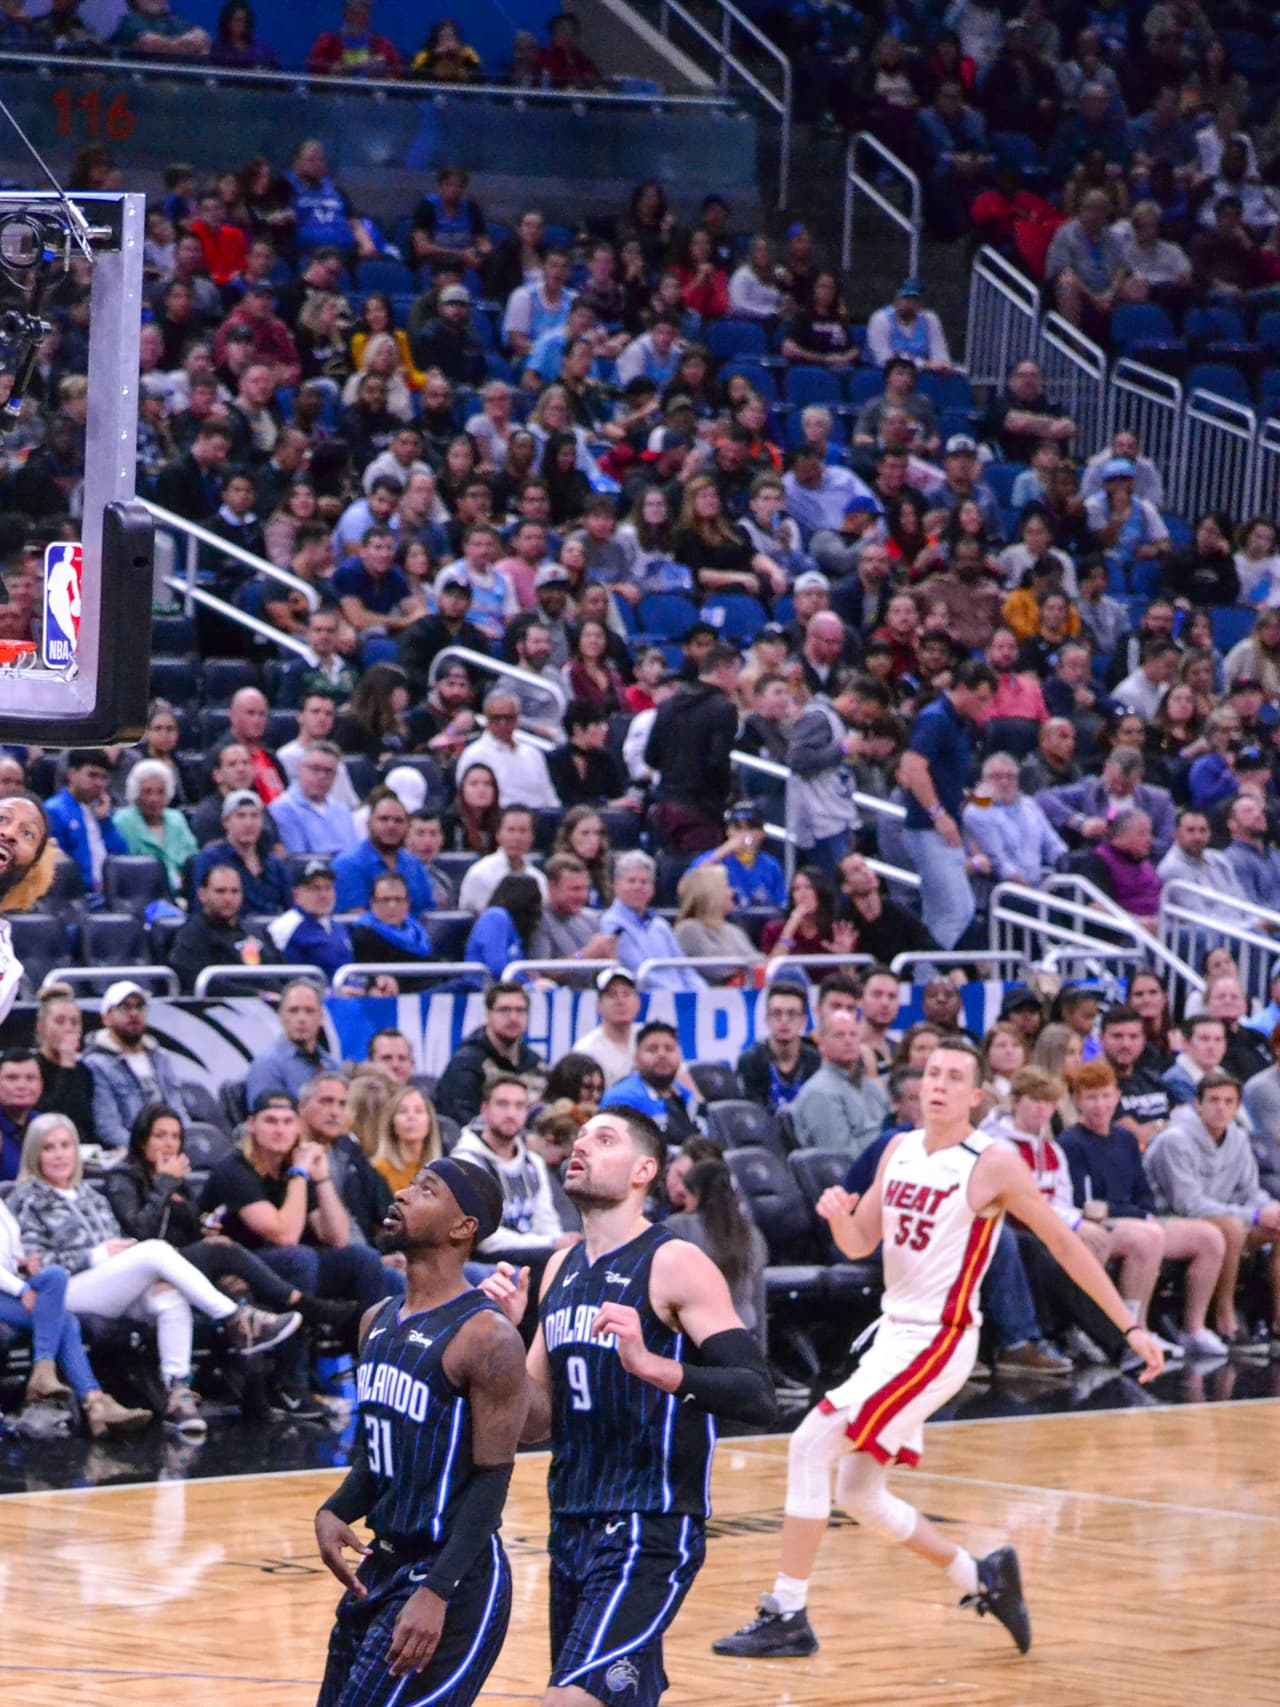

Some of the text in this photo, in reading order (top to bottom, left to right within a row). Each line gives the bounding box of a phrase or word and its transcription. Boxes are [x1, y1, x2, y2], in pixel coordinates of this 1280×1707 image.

[51, 88, 136, 139] 116
[48, 640, 69, 660] NBA
[884, 1179, 960, 1216] HEAT
[894, 1213, 935, 1252] 55
[567, 1356, 592, 1411] 9
[364, 1413, 395, 1479] 31
